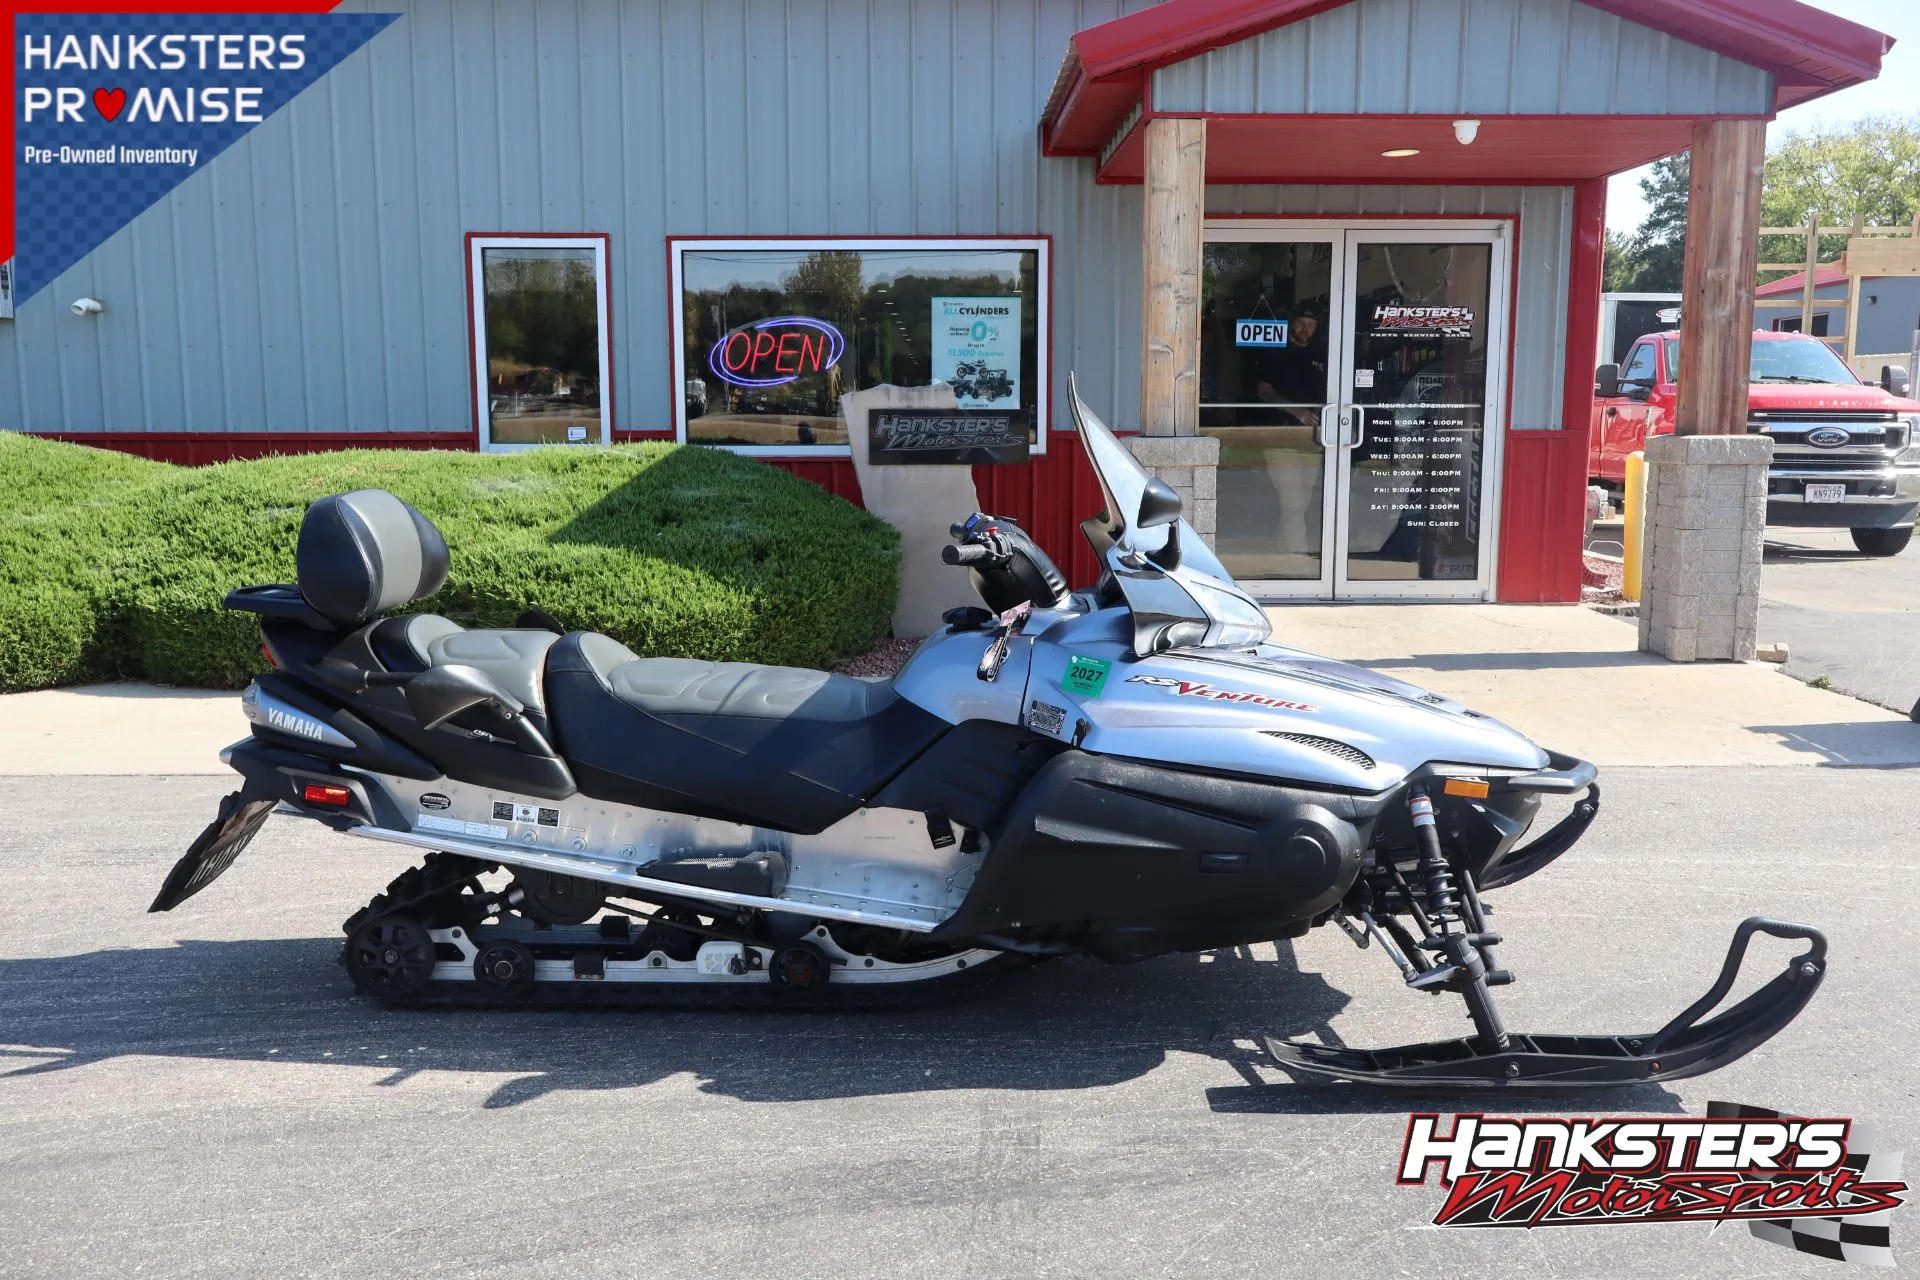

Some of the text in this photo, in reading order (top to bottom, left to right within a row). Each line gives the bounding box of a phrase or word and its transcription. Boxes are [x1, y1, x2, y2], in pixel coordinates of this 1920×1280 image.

[1240, 324, 1284, 343] OPEN
[724, 331, 825, 373] OPEN
[1817, 432, 1839, 442] Ford
[1070, 665, 1104, 683] 2027
[1124, 674, 1180, 687] RS
[268, 706, 324, 741] YAMAHA
